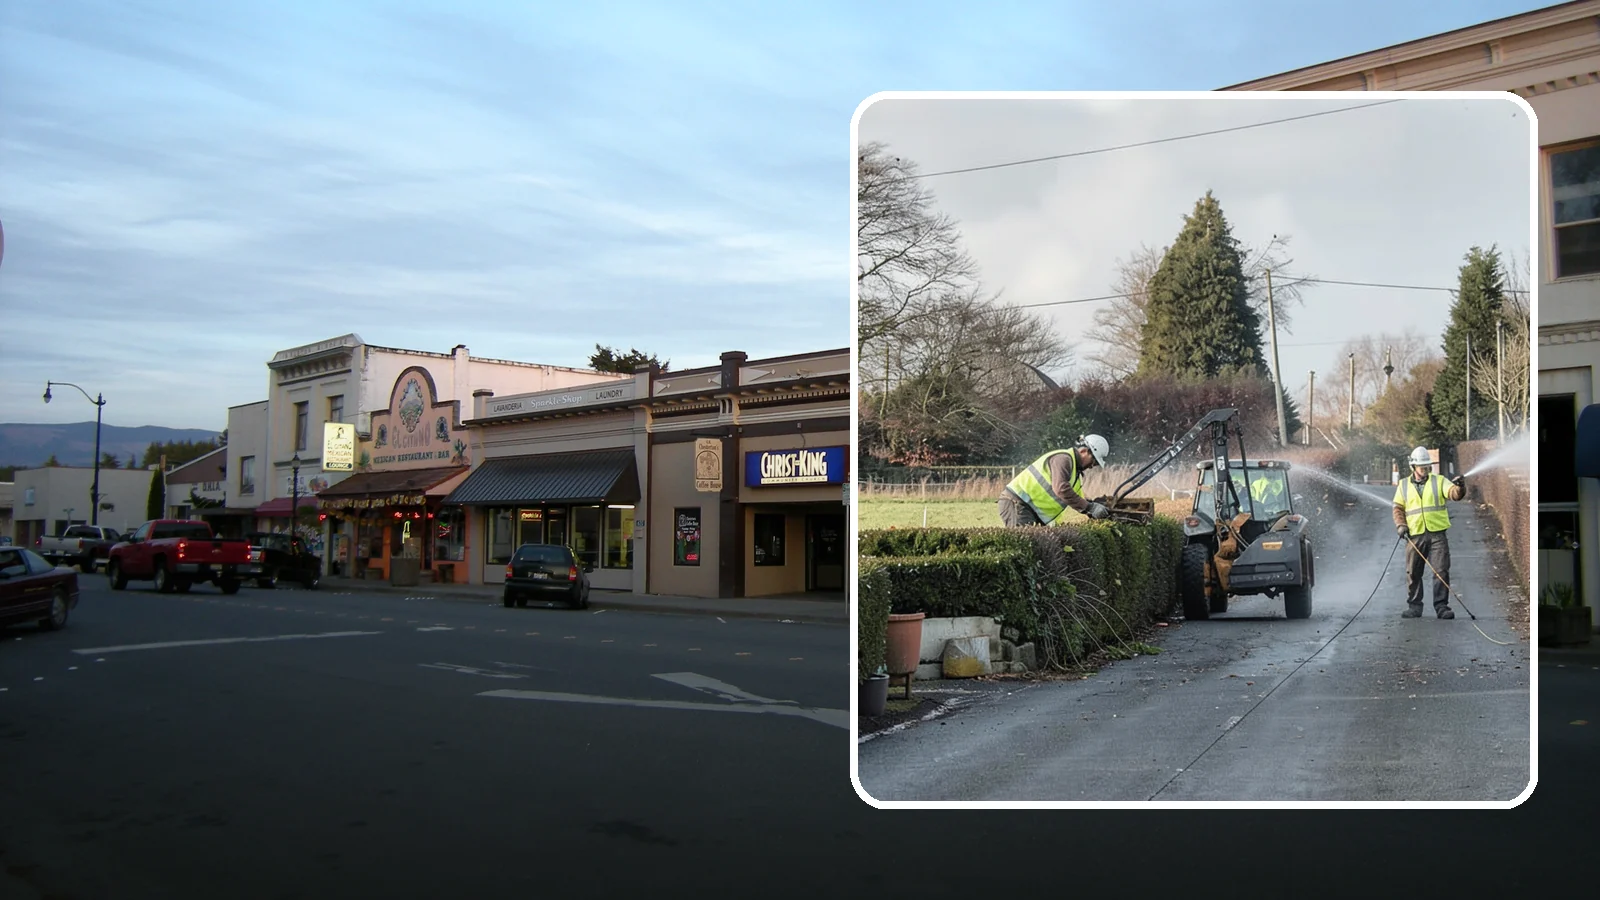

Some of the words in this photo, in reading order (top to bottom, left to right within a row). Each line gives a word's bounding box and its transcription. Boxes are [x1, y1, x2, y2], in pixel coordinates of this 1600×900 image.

[595, 389, 623, 399] LAUNDRY
[493, 402, 522, 412] LAVANDERIA
[531, 398, 560, 409] Sparkle
[562, 394, 582, 404] Shop
[373, 455, 396, 464] MEXICAN
[397, 452, 433, 462] RESTAURANT
[437, 451, 450, 459] BAR
[761, 452, 797, 478] CHRIST
[799, 450, 827, 476] KING
